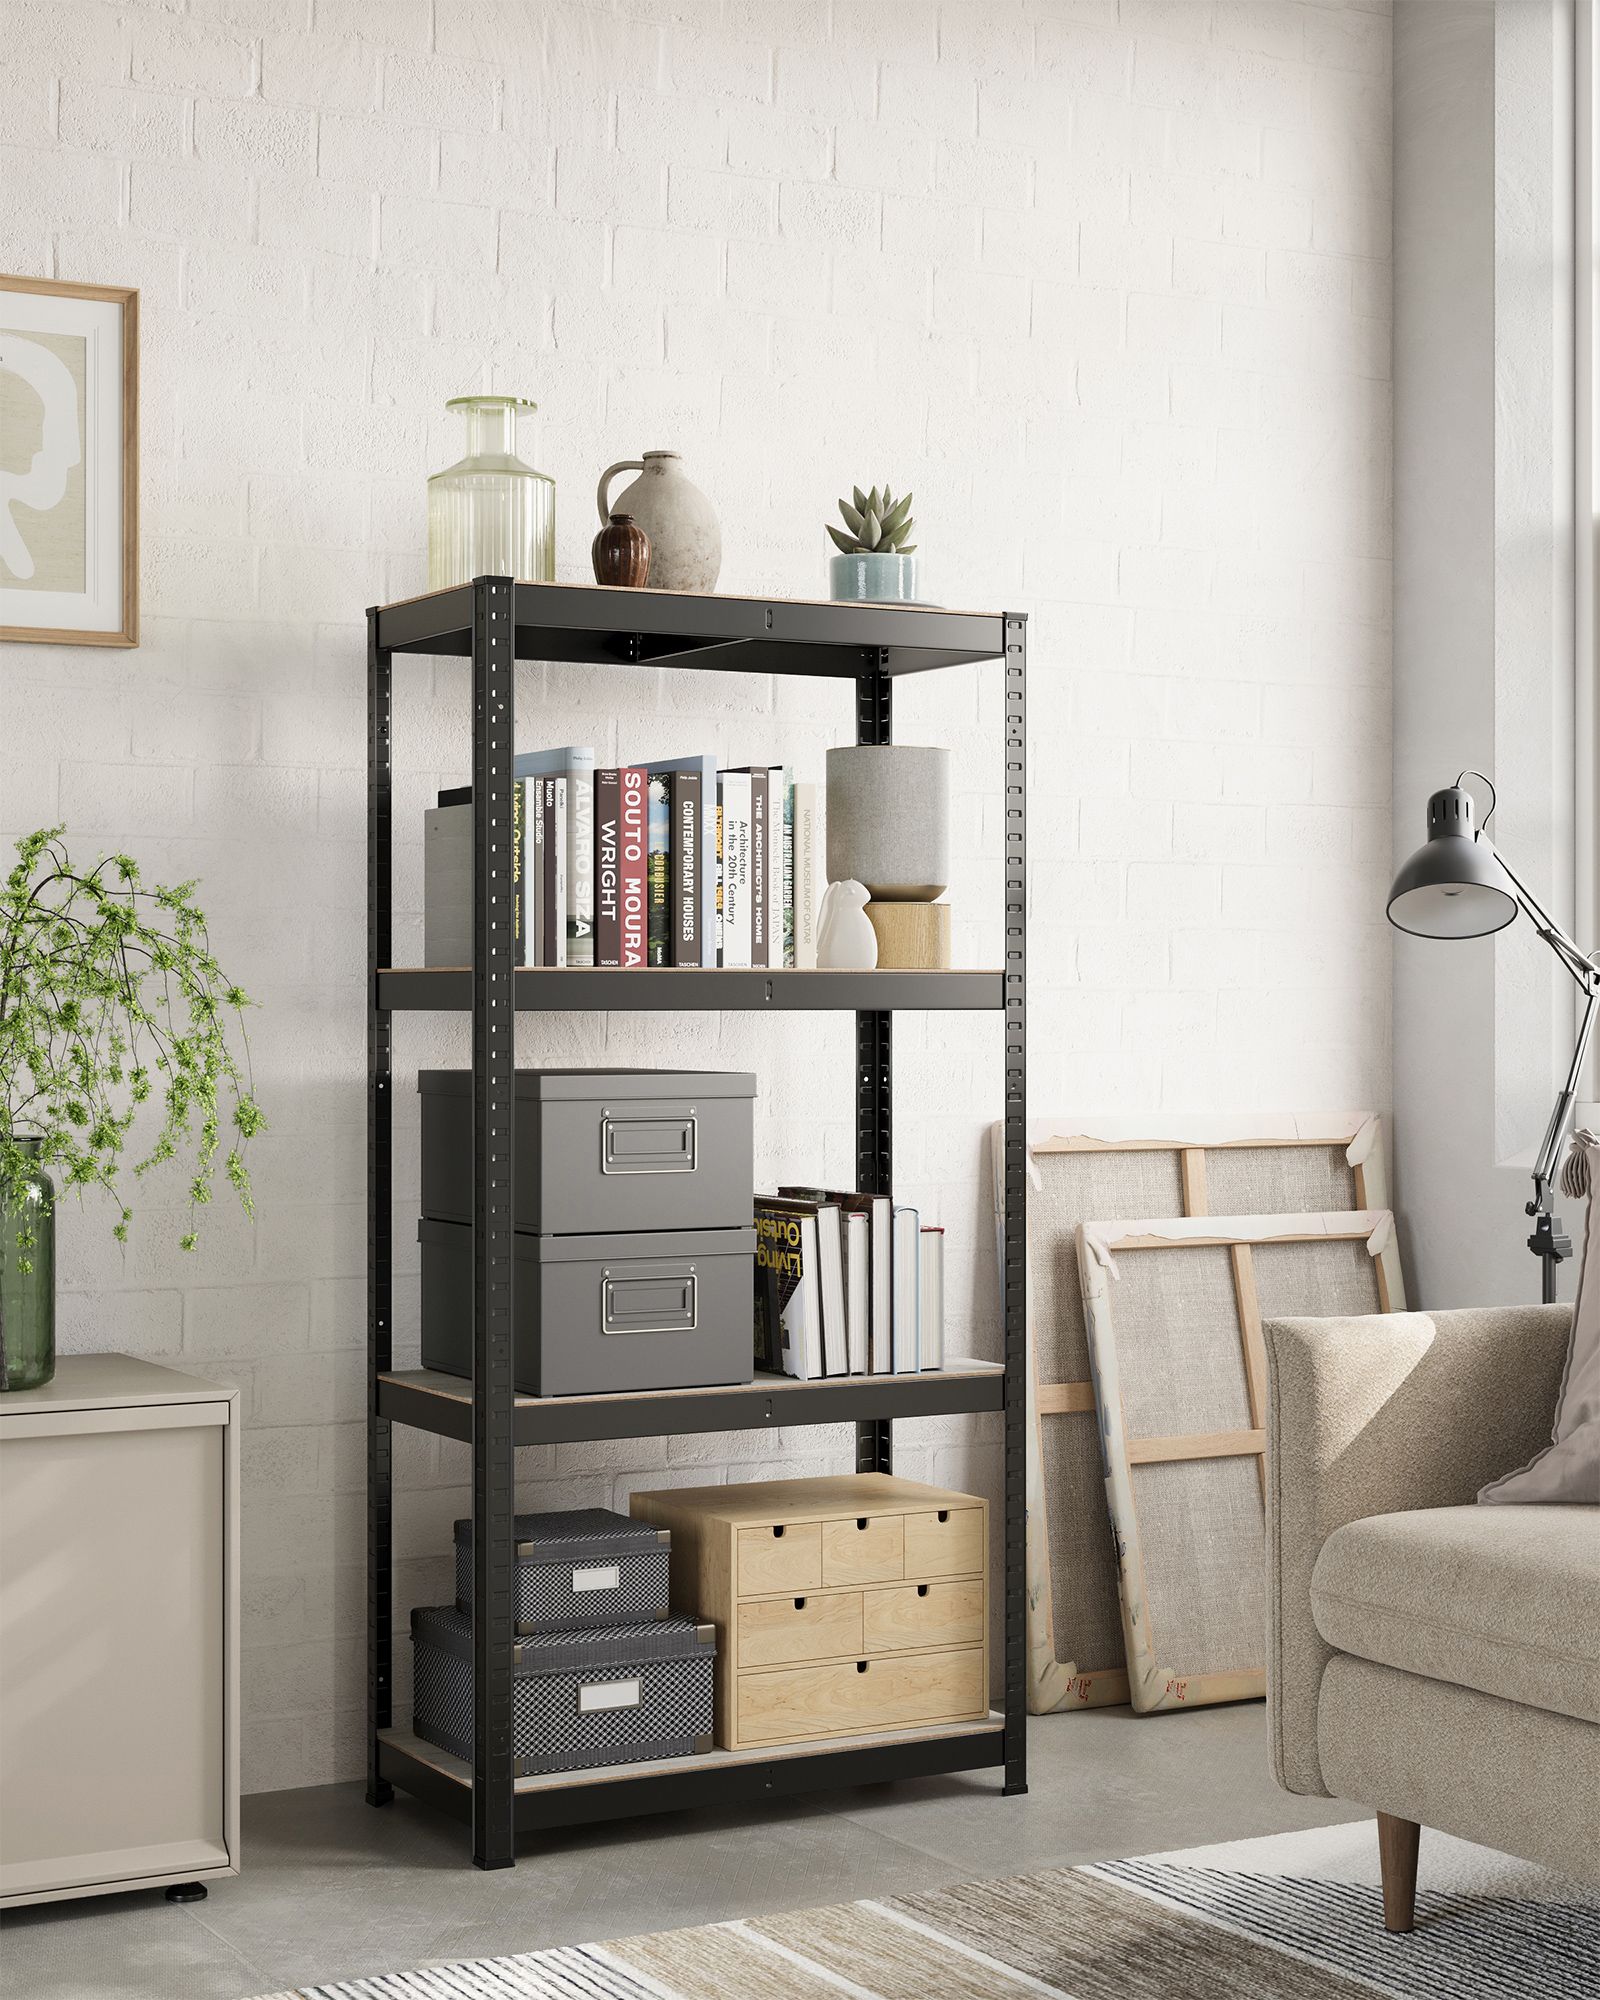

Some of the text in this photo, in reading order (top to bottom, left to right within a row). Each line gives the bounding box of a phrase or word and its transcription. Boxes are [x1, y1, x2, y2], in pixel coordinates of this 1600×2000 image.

[536, 781, 544, 844] Ensamble Studio
[546, 781, 554, 807] Muoto
[601, 820, 616, 920] WRIGHT
[624, 773, 641, 967] SOUTO MOURA
[654, 854, 665, 904] CORBUSIER
[683, 801, 694, 941] CONTEMPORARY HOUSES
[726, 821, 737, 925] in the 20th Century
[739, 821, 748, 884] Architecture
[783, 824, 793, 908] AN AUSTRALIAN GARDEN
[803, 809, 811, 944] NATIONAL MUSEUM OF QATAR
[575, 881, 591, 938] SIZA
[753, 1218, 799, 1246] Outsi
[757, 1243, 801, 1277] Living
